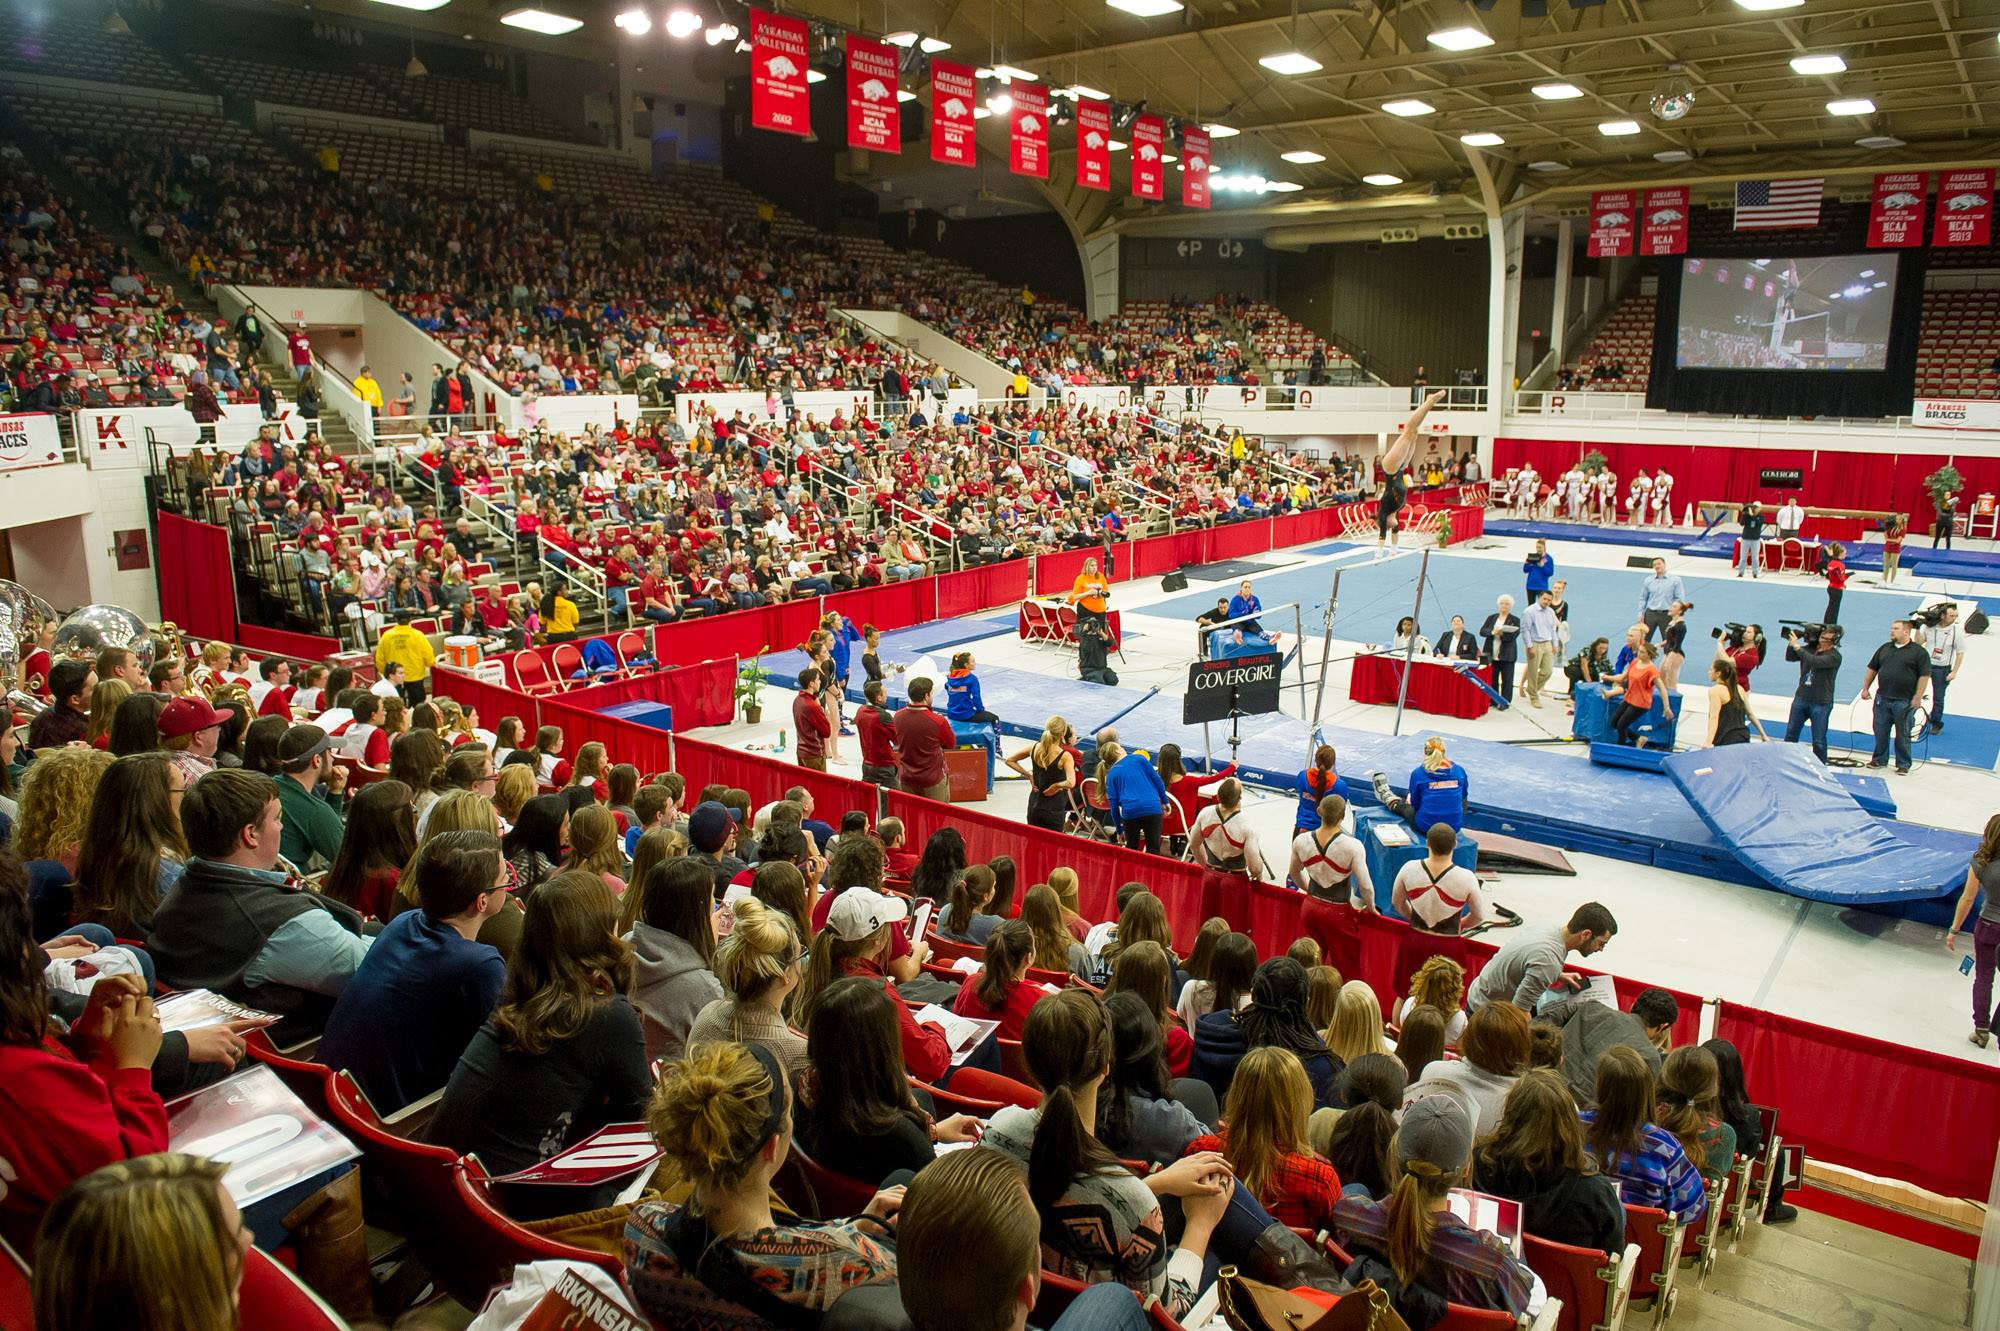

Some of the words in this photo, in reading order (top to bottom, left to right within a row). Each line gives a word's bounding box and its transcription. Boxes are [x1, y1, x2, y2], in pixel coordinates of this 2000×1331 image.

[853, 50, 894, 67] ARKANSAS
[851, 60, 896, 79] VOLLEYBALL
[864, 116, 885, 128] NCAA
[945, 132, 963, 144] NCAA
[1884, 174, 1919, 183] ARKANSAS
[1949, 173, 1986, 182] ARKANSAS
[1882, 222, 1907, 232] NCAA
[1948, 221, 1974, 232] NCAA
[1600, 237, 1619, 247] NCAA
[1653, 235, 1673, 245] NCAA
[1883, 232, 1905, 243] 2012
[1948, 232, 1972, 242] 2013
[1190, 241, 1202, 256] P
[1601, 246, 1617, 256] 2011
[1654, 245, 1670, 255] 2011
[1551, 396, 1565, 413] R
[1926, 403, 1967, 411] Arkansas
[1925, 411, 1967, 419] BRACES
[96, 416, 127, 449] K
[1195, 664, 1276, 690] COVERGIRL
[869, 916, 879, 930] 3
